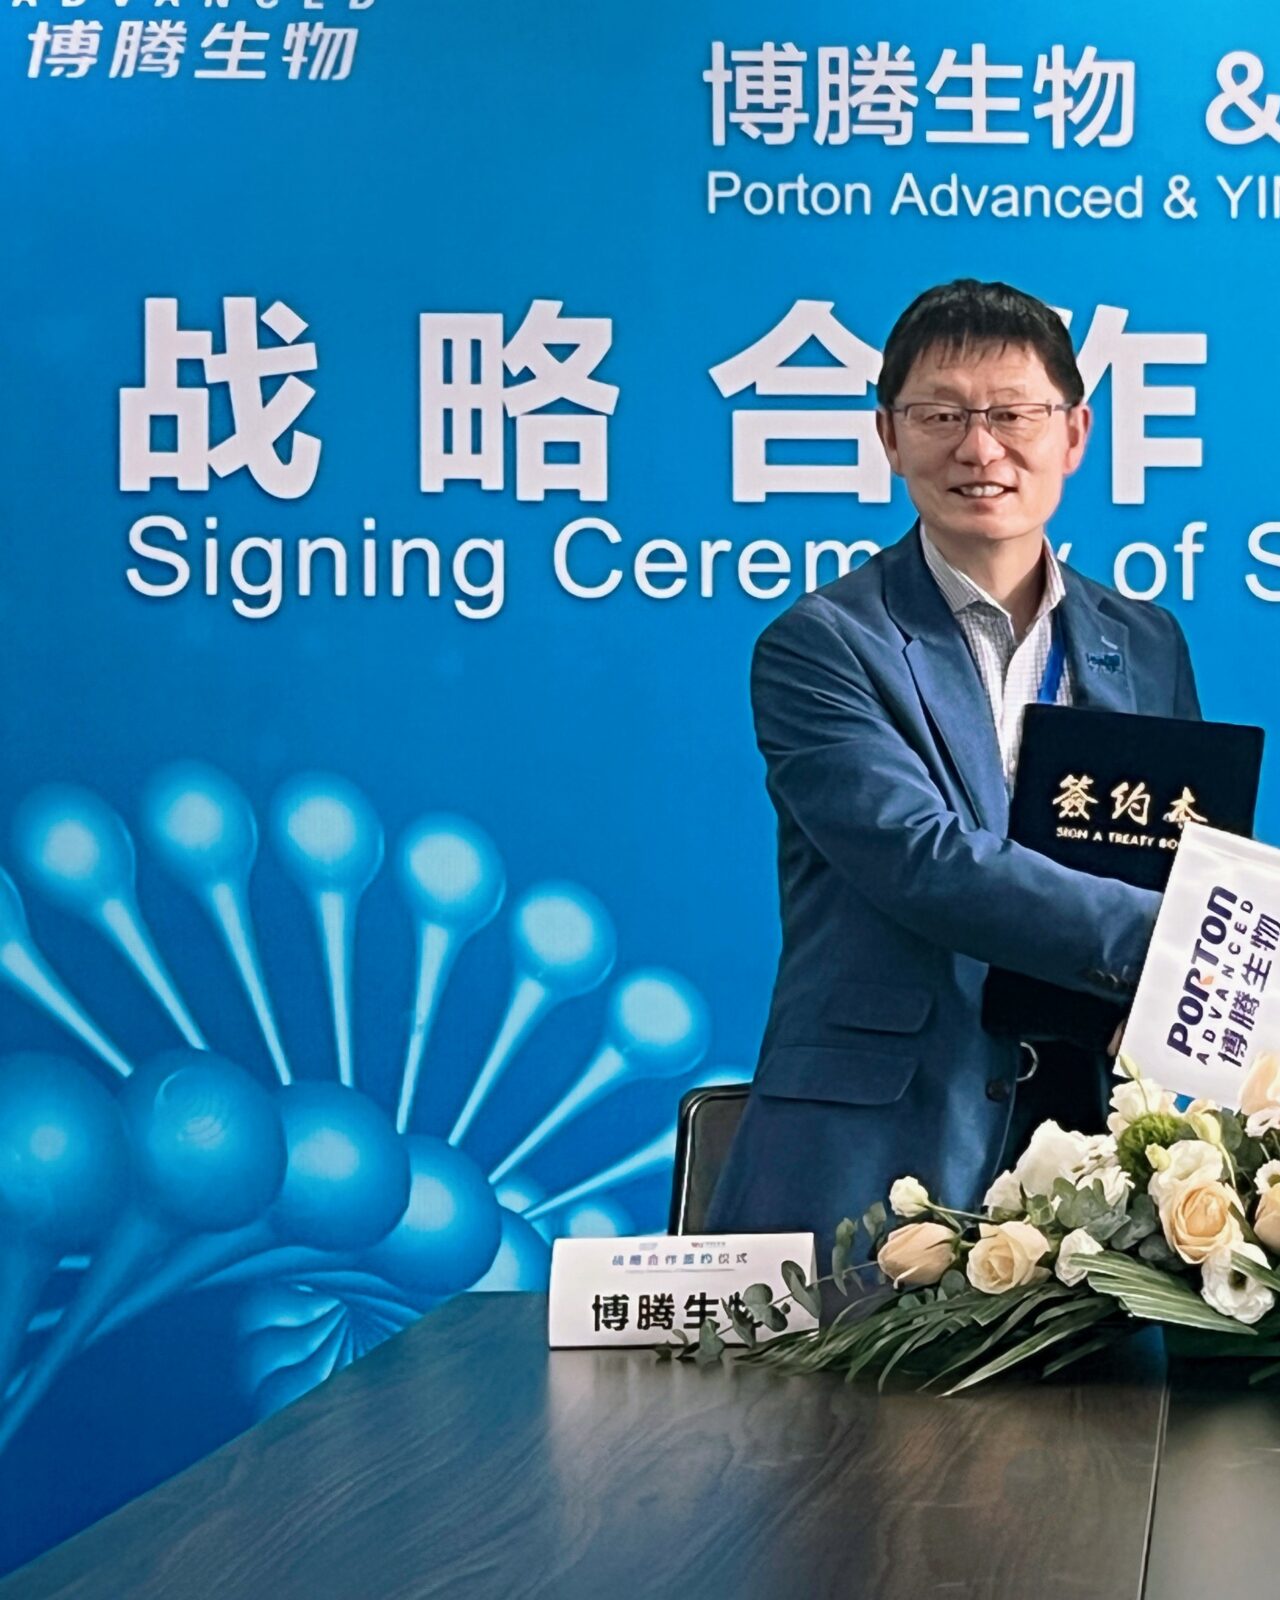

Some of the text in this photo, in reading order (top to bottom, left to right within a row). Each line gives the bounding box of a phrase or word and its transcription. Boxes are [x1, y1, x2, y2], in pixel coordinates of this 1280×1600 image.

[28, 20, 359, 80] 博腾生物
[703, 42, 1135, 149] 博腾生物
[707, 172, 871, 216] Porton
[891, 173, 1142, 218] Advanced
[1164, 175, 1198, 218] &
[126, 515, 504, 619] Signing
[1113, 522, 1208, 602] of
[1093, 832, 1103, 841] A
[1196, 900, 1254, 1065] ADVANCED
